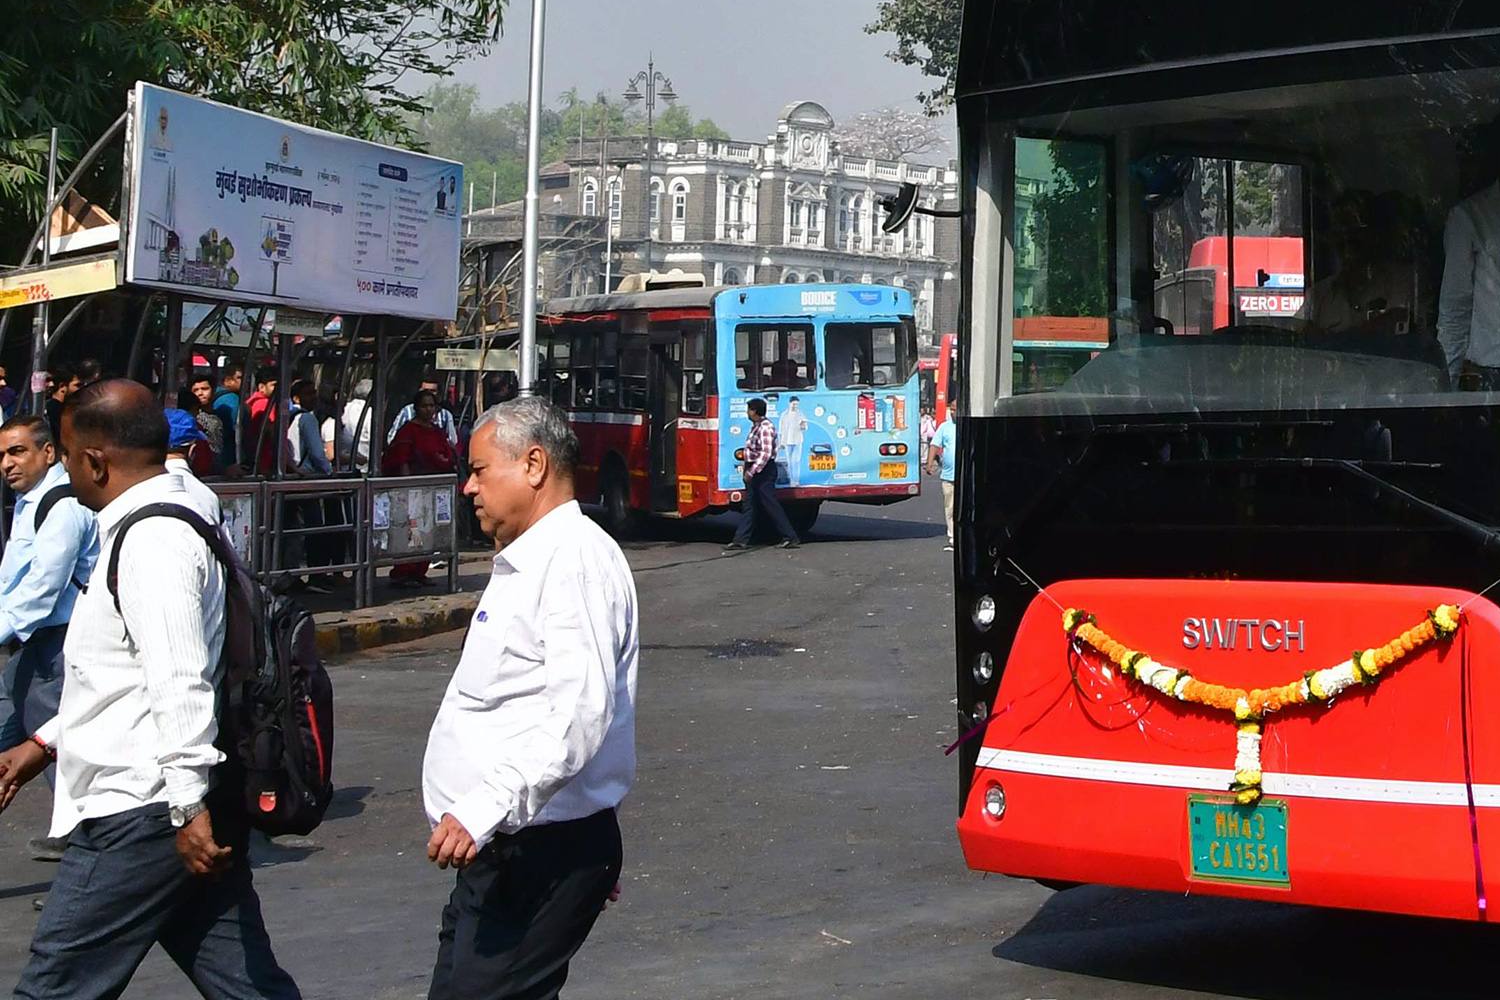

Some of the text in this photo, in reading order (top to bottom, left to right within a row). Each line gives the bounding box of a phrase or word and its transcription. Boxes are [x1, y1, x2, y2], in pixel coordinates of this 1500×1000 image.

[216, 166, 238, 199] मुंबई
[1240, 296, 1278, 311] ZERO
[1182, 617, 1304, 652] SWITCH
[1209, 841, 1280, 872] CA1551
